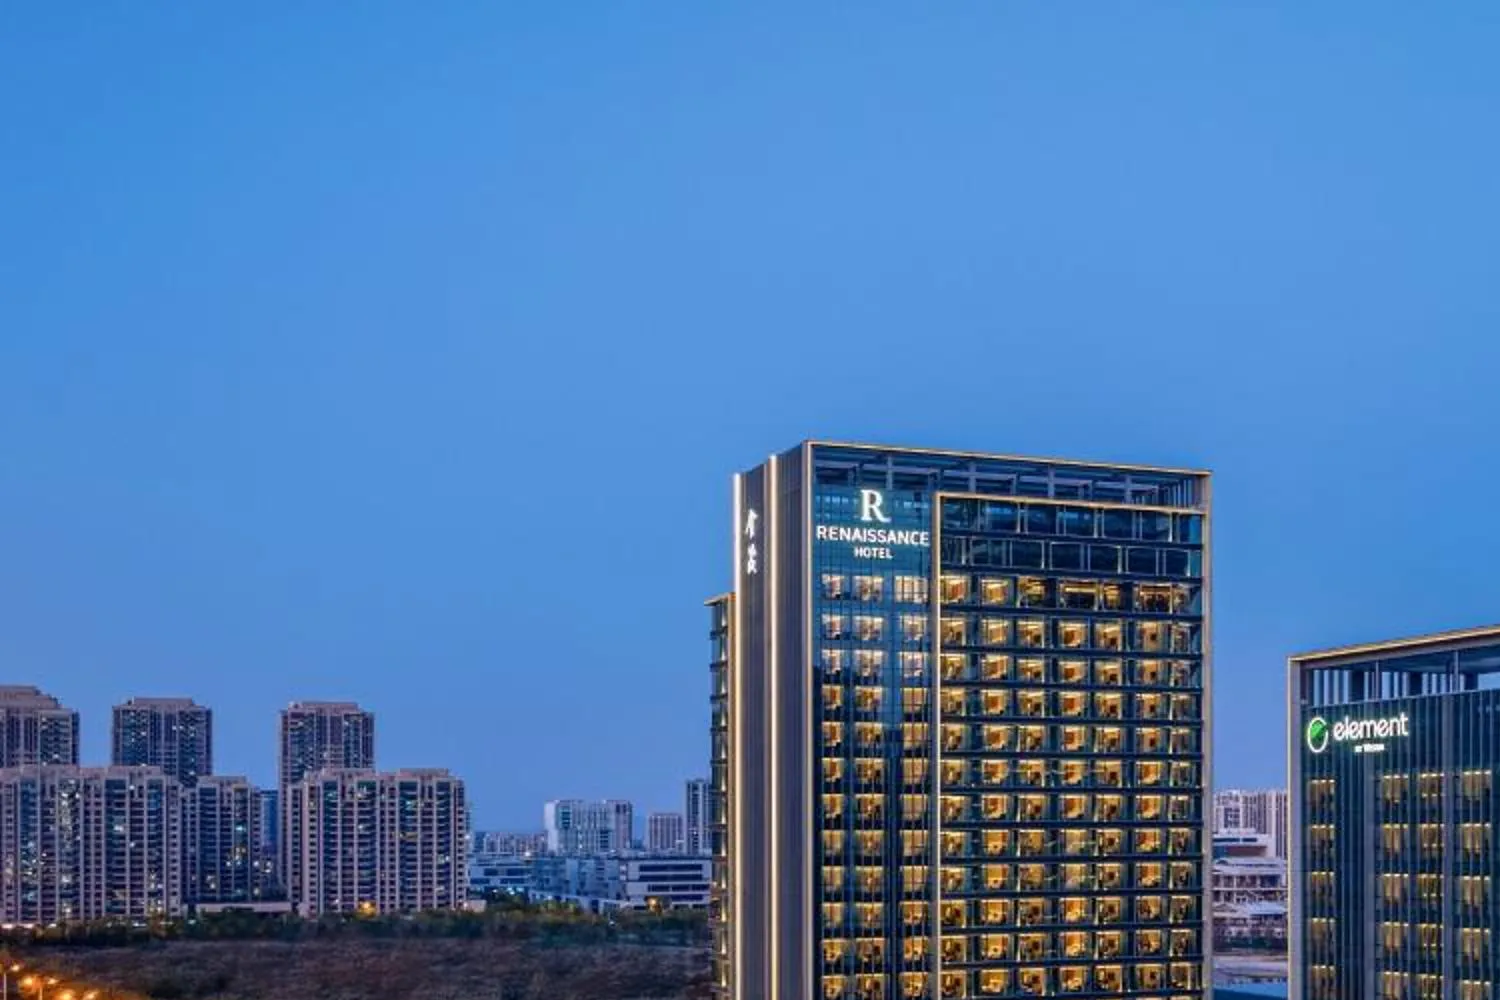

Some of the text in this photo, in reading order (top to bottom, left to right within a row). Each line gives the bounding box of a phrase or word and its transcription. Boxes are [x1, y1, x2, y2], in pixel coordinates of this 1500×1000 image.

[860, 489, 891, 523] R
[816, 525, 930, 547] RENAISSANCE
[854, 548, 893, 560] HOTEL
[1333, 711, 1409, 740] element
